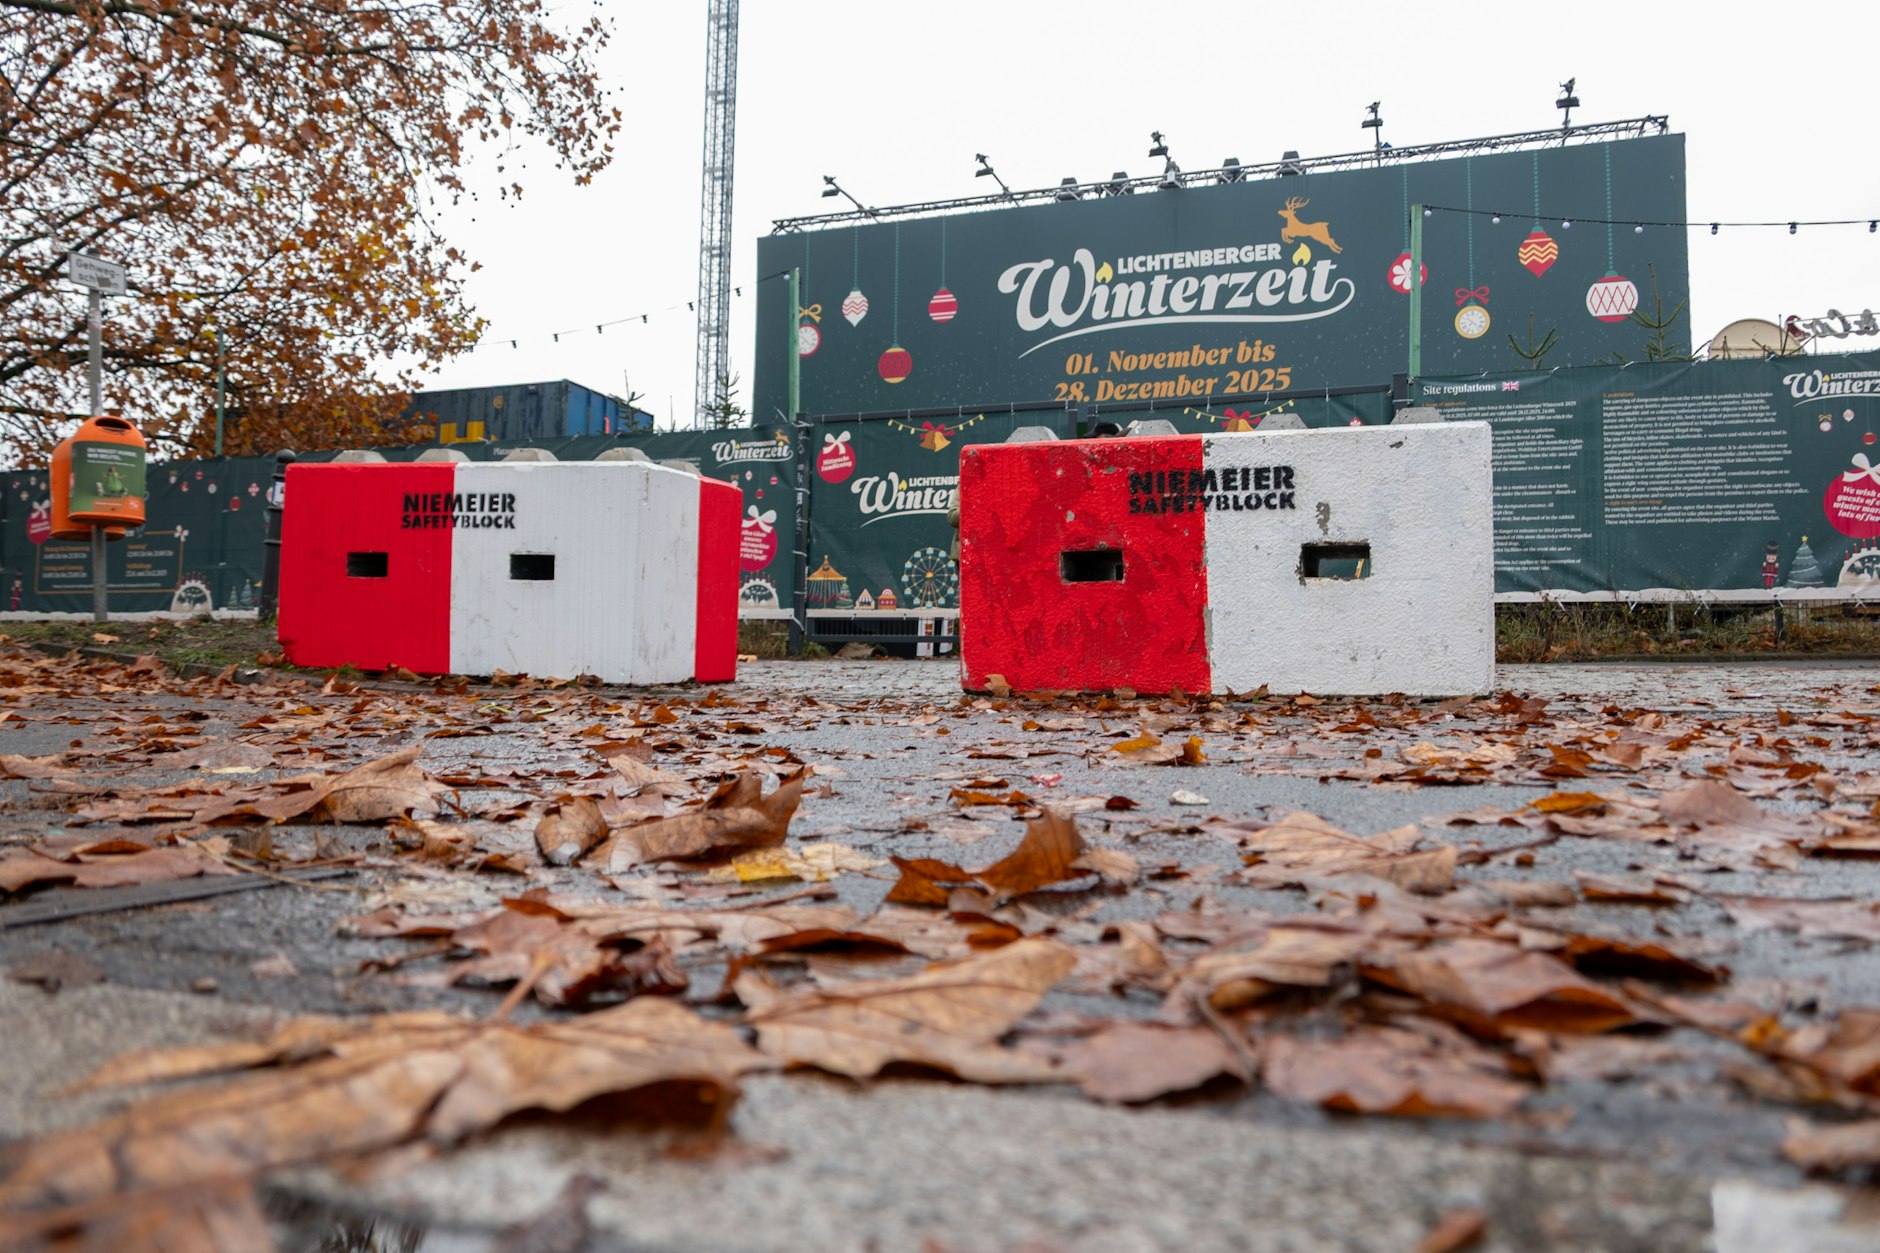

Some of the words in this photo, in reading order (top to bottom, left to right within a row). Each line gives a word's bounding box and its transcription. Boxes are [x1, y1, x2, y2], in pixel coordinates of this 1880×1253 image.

[1117, 243, 1282, 274] LICHTENBERGER
[76, 259, 119, 279] Gehweg-
[78, 273, 118, 289] schn
[998, 247, 1355, 354] Winterzeit
[1065, 353, 1098, 375] 01.
[1106, 345, 1233, 373] November
[1236, 340, 1275, 364] bis
[1054, 382, 1090, 402] 28.
[1095, 374, 1218, 402] Dezember
[1223, 367, 1292, 394] 2025
[1423, 385, 1441, 395] Site
[1443, 383, 1496, 396] regulations
[712, 439, 793, 466] Winterzeit
[1128, 465, 1295, 494] NIEMEIER
[1836, 494, 1865, 504] guests
[1865, 497, 1877, 506] of
[1843, 485, 1855, 494] We
[1855, 488, 1877, 497] wish
[403, 493, 516, 513] NIEMEIER
[1129, 491, 1296, 514] SAFETYBLOCK
[1833, 501, 1861, 511] winter
[402, 514, 516, 529] SAFETYBLOCK
[1838, 510, 1855, 519] lots
[1855, 513, 1867, 521] of
